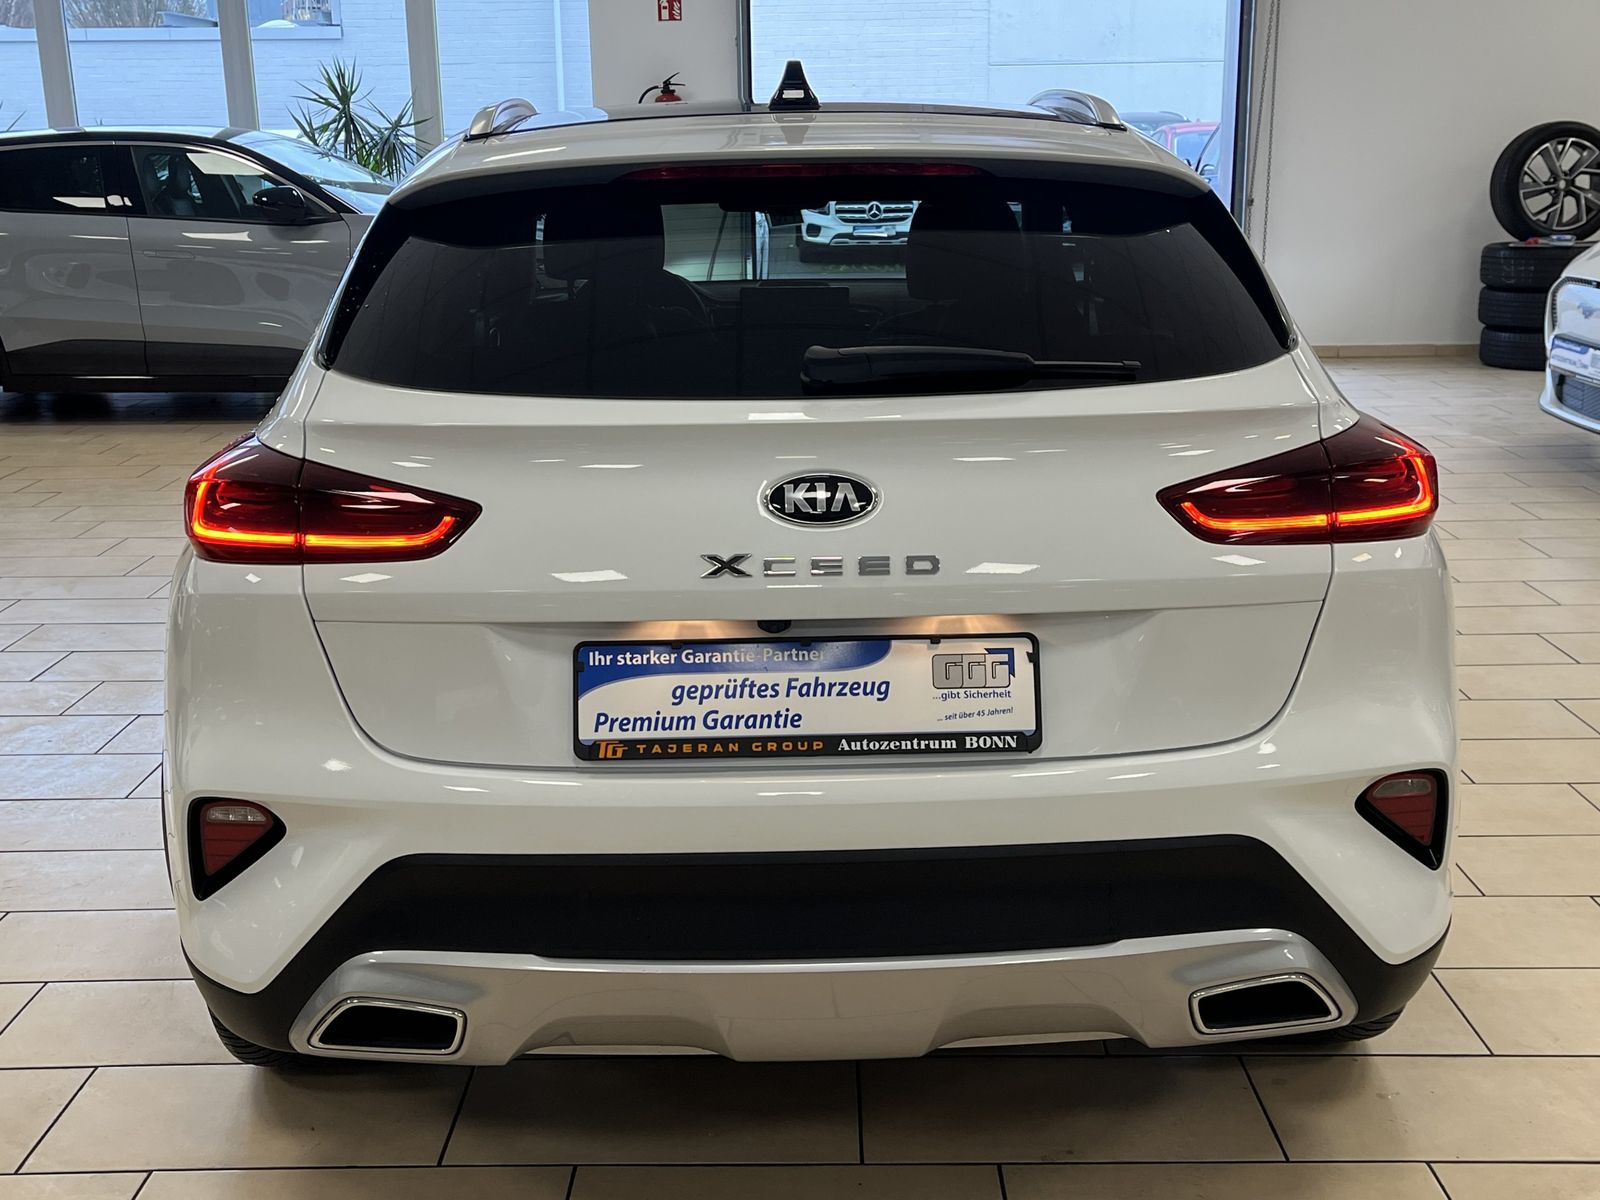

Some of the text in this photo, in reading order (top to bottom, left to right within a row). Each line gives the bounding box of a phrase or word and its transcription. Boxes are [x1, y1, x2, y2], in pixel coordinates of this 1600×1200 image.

[783, 482, 861, 513] KIA
[700, 553, 941, 579] XCEED
[589, 651, 612, 666] Ihr
[616, 649, 677, 666] starker
[671, 676, 891, 706] geprüftes Fahrzeug
[963, 689, 1012, 699] Sicherheit
[593, 708, 803, 733] Premium Garantie
[944, 713, 958, 721] seit
[958, 711, 975, 719] über
[976, 709, 986, 717] 45
[986, 706, 1014, 716] Jahren!
[636, 743, 739, 754] TAJERAN
[751, 740, 824, 752] GROUP
[837, 737, 957, 751] Autozentrum
[964, 734, 1019, 749] BONN
